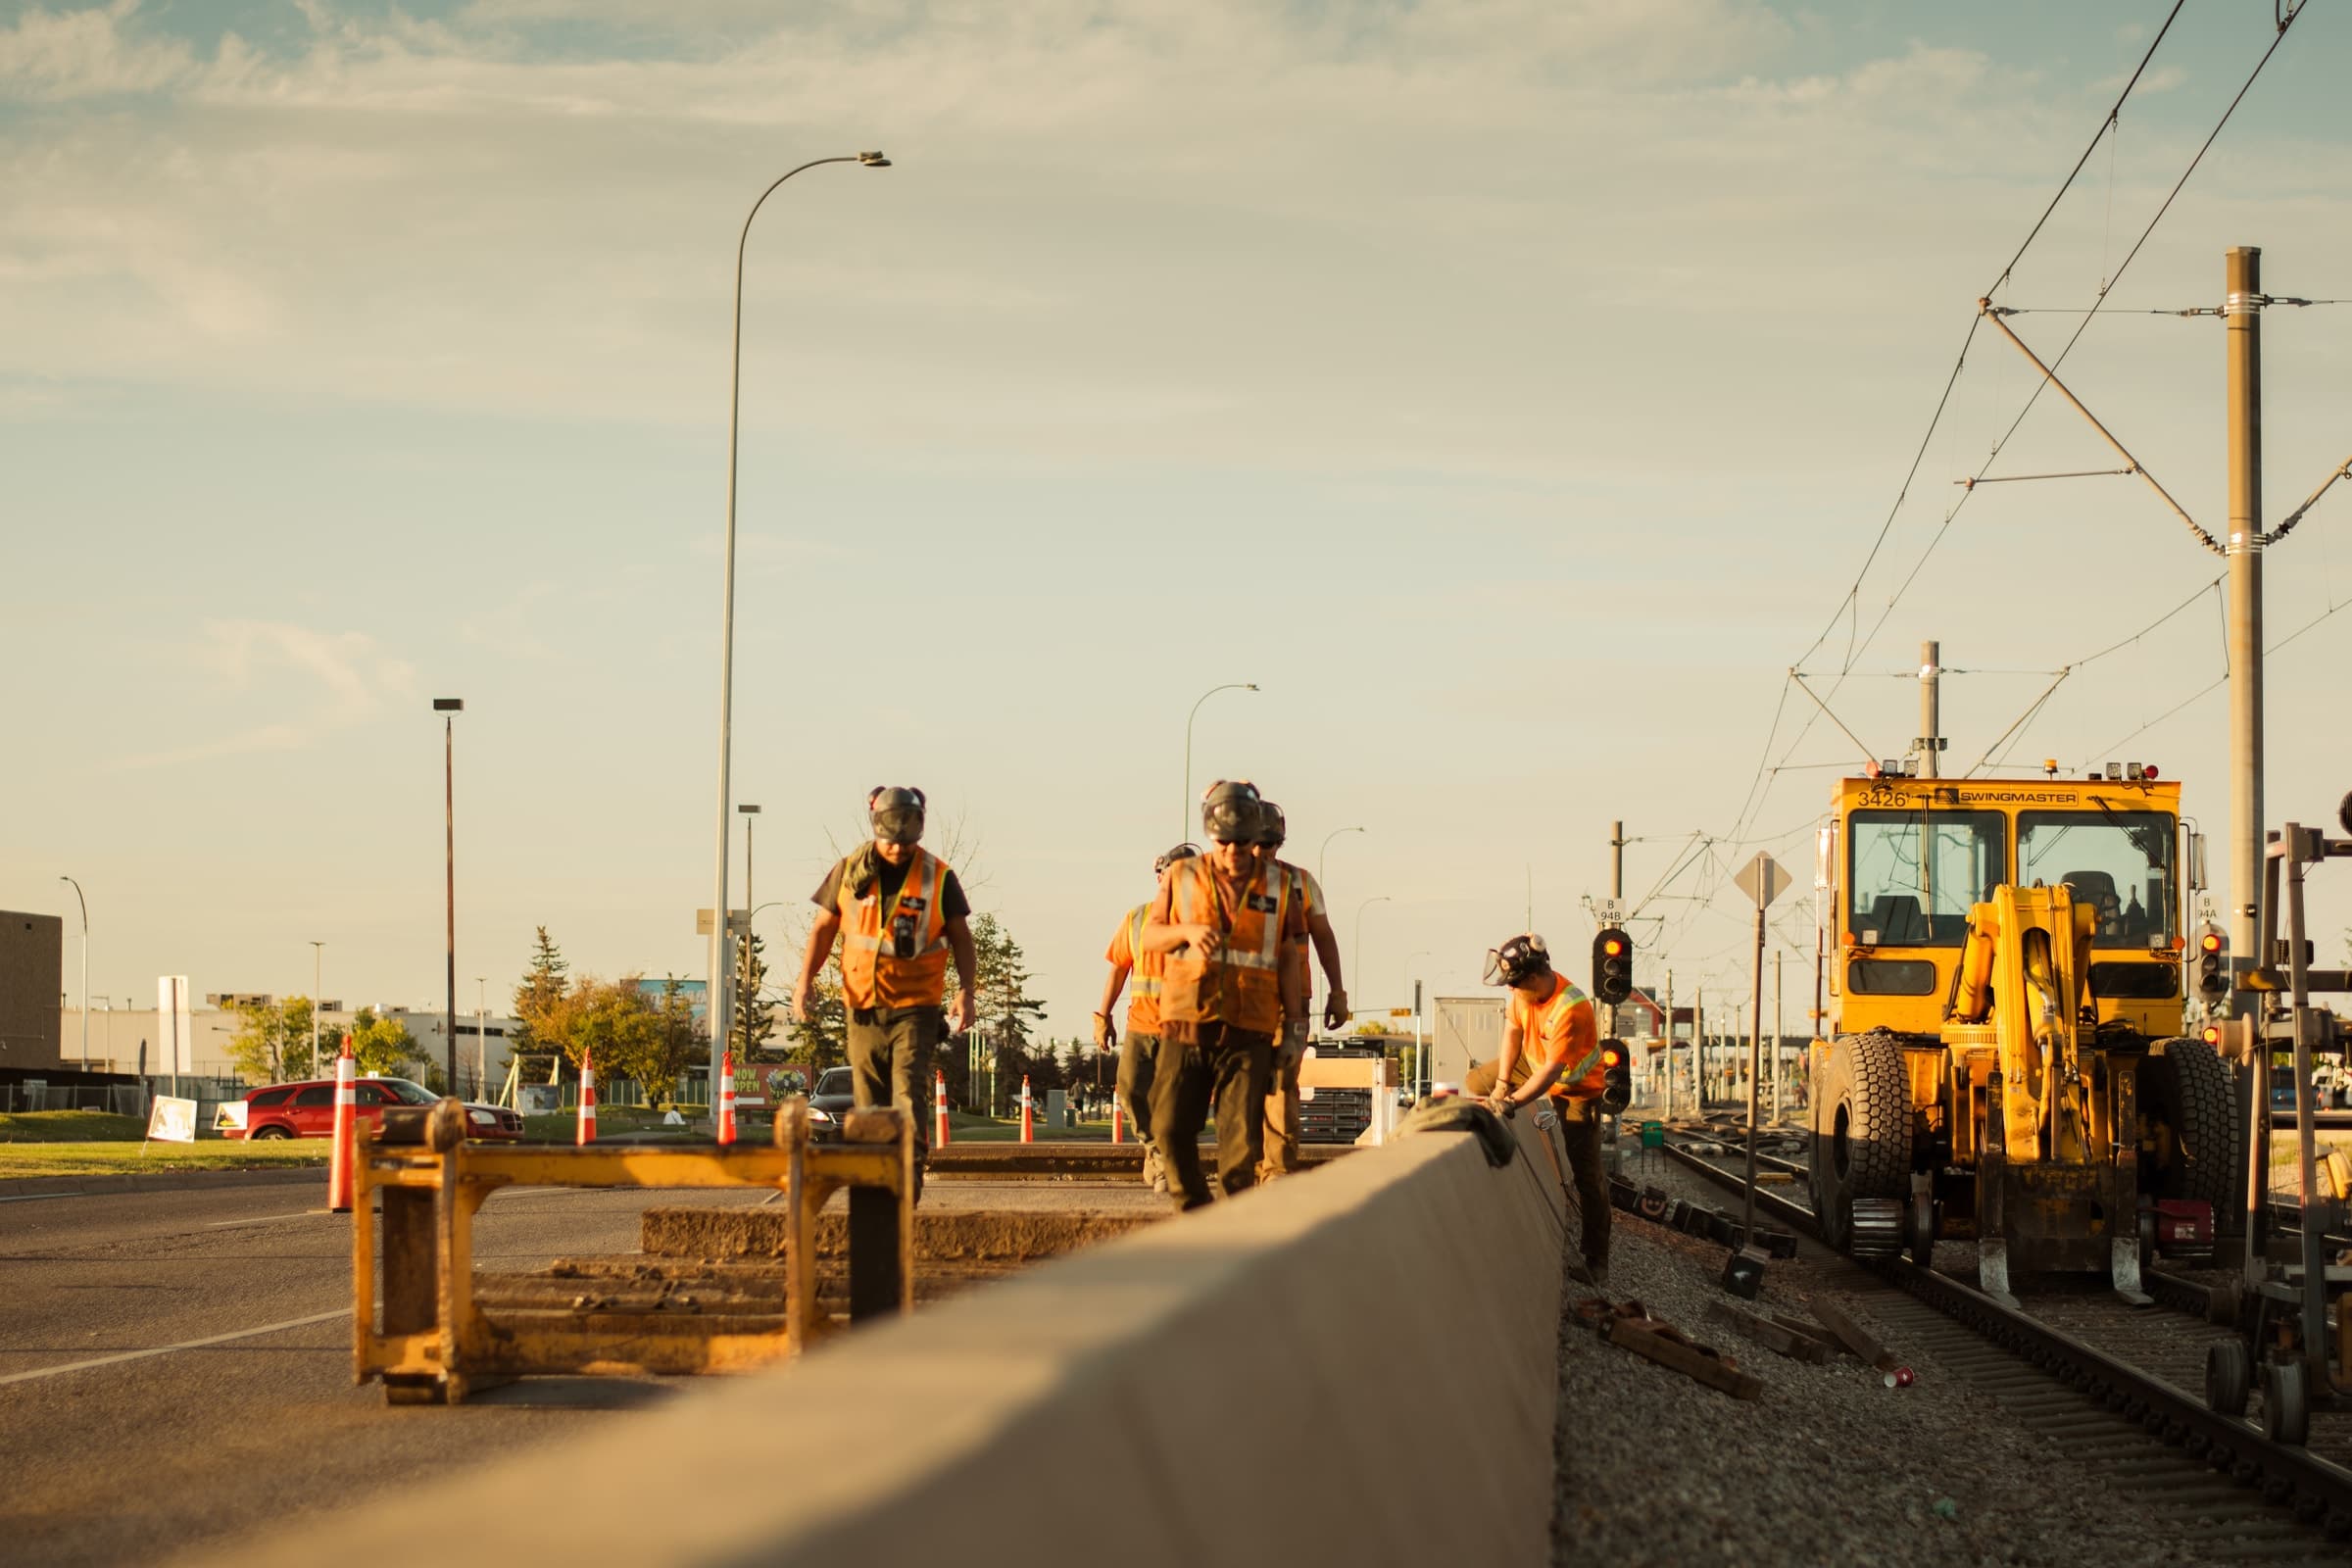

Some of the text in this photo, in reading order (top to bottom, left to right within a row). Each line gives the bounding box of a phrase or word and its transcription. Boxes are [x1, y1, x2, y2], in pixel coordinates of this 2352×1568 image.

[1858, 791, 1906, 808] 3426
[1961, 792, 2077, 803] SWINGMASTER
[1608, 900, 1614, 909] B
[1601, 911, 1621, 921] 94B
[734, 1069, 757, 1079] NOW
[734, 1081, 760, 1092] OPEN
